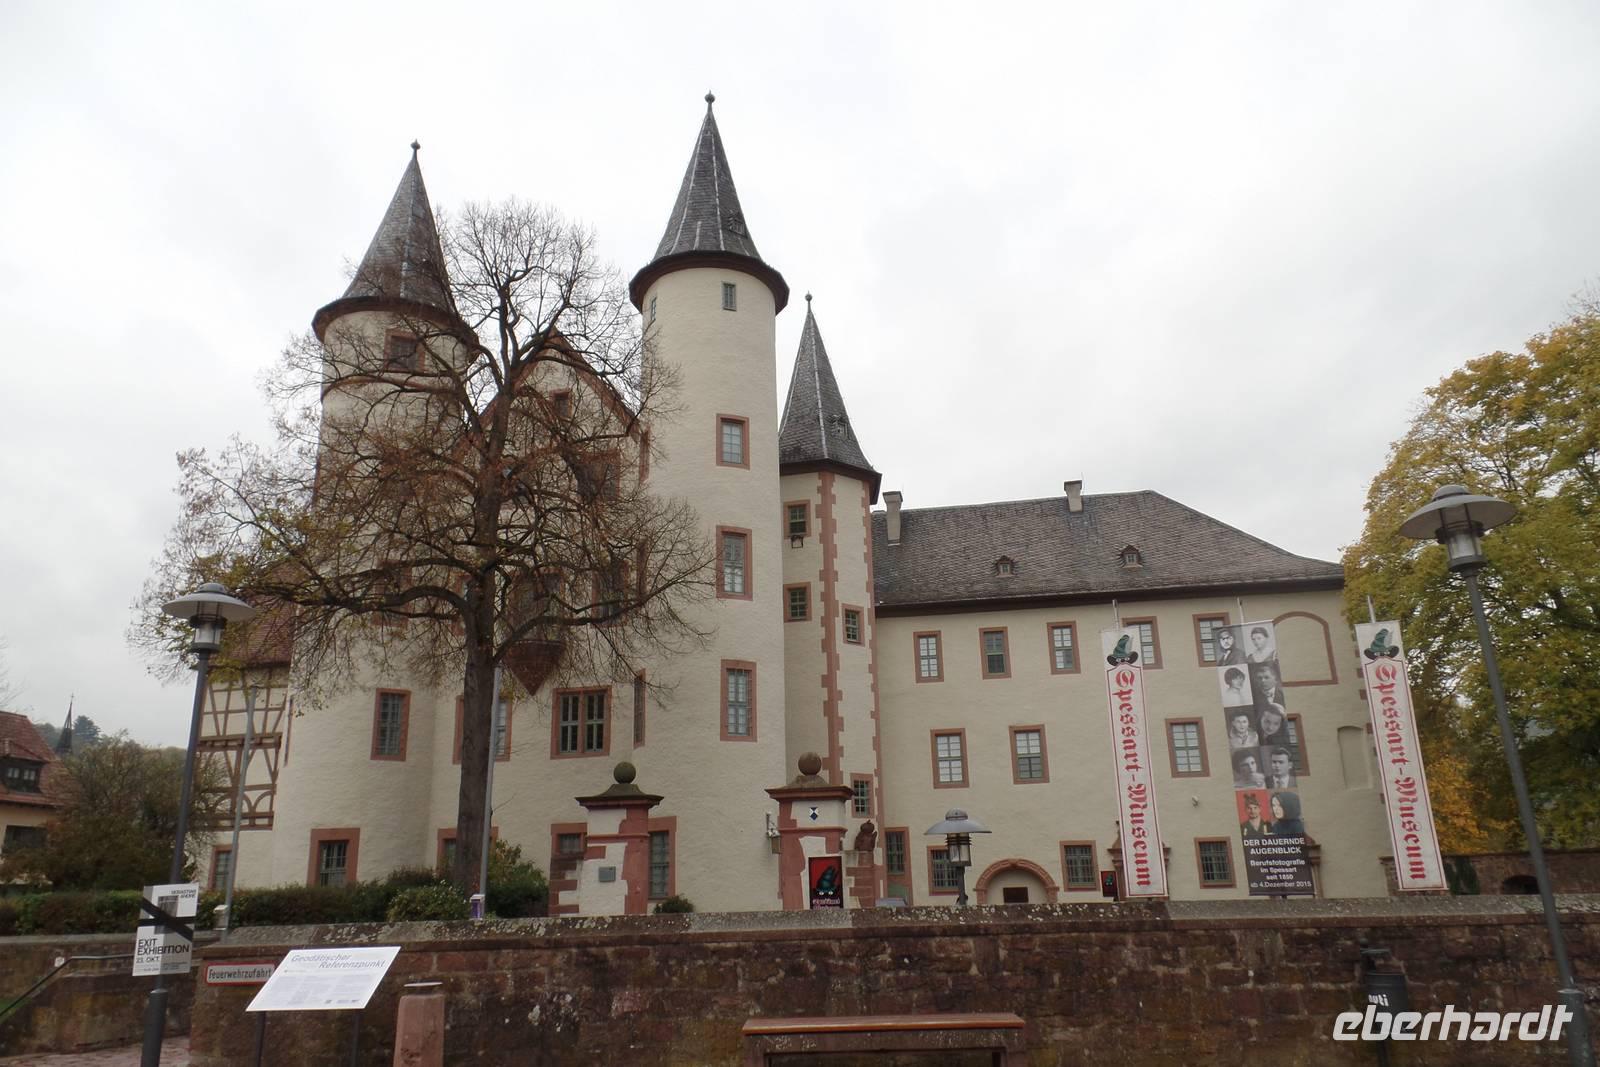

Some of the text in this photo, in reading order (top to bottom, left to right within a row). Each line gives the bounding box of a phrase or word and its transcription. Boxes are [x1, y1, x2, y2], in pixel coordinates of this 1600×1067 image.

[1372, 664, 1426, 880] Spessart-Museum
[1112, 670, 1151, 886] Spessart-Museum
[1243, 837, 1305, 846] DER DAUERNDE
[1250, 846, 1302, 855] AUGENBLICK
[138, 939, 157, 948] EXIT
[137, 945, 190, 956] EXHIBITION
[291, 954, 352, 963] Geodätischer
[318, 960, 386, 969] Referenzpunkt
[208, 968, 272, 980] Feuerwehrzufahrt
